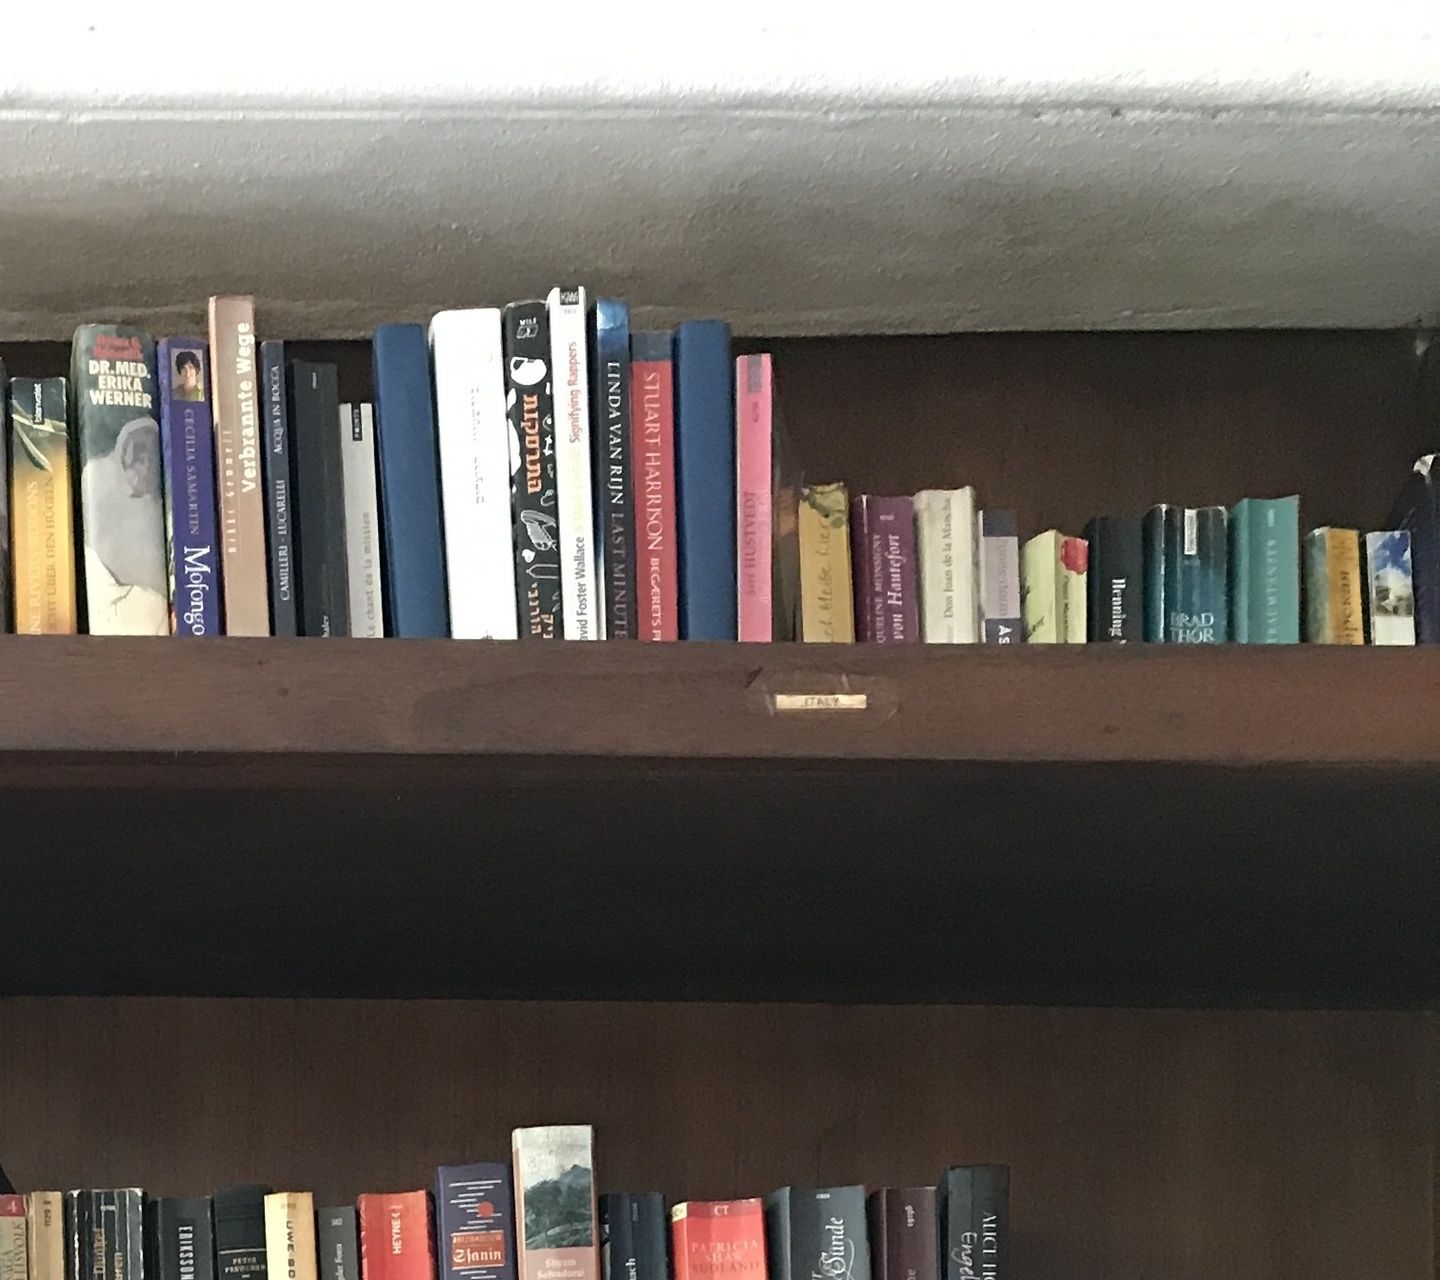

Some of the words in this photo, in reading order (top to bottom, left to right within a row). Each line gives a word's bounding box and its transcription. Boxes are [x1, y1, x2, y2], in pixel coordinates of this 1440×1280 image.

[234, 322, 255, 375] Wege
[566, 341, 580, 388] Rappers
[88, 389, 153, 409] WERNER
[98, 375, 143, 391] ERIKA
[269, 365, 281, 403] BOCCA
[607, 362, 622, 419] LINDA
[183, 408, 198, 461] CECILIA
[568, 389, 582, 444] Signifying
[642, 372, 662, 447] STUART
[236, 381, 258, 493] Verbrannte
[271, 418, 285, 455] ACQUA
[608, 423, 623, 460] VAN
[185, 465, 201, 535] SAMARTIN
[274, 479, 288, 535] LUCARELLI
[608, 464, 624, 505] RIJN
[645, 450, 664, 550] HARRISON
[360, 511, 372, 555] mission
[574, 536, 587, 580] Wallace
[611, 512, 626, 558] LAST
[183, 545, 212, 636] Mofongo
[277, 545, 291, 601] CAMILLERI
[575, 580, 588, 616] Foster
[613, 562, 628, 638] MINUTE
[1108, 578, 1127, 637] Henning
[803, 696, 841, 707] ITALY
[390, 1216, 403, 1255] HEYNE
